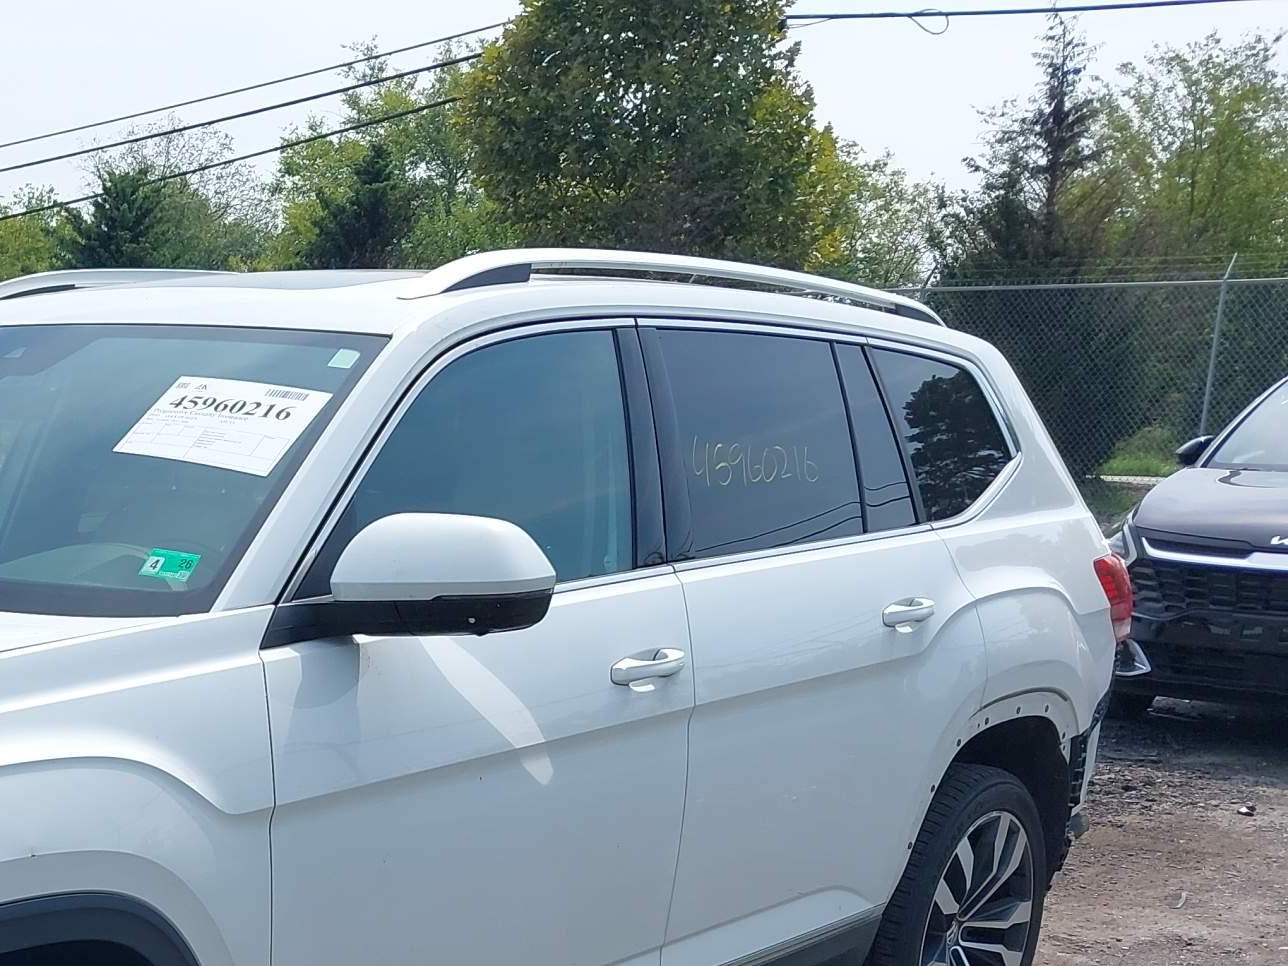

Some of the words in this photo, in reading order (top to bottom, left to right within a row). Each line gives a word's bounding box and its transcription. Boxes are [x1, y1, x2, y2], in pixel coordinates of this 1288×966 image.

[169, 394, 296, 421] 45960216
[692, 435, 819, 487] 45960216
[149, 559, 161, 570] 4
[178, 558, 194, 570] 26
